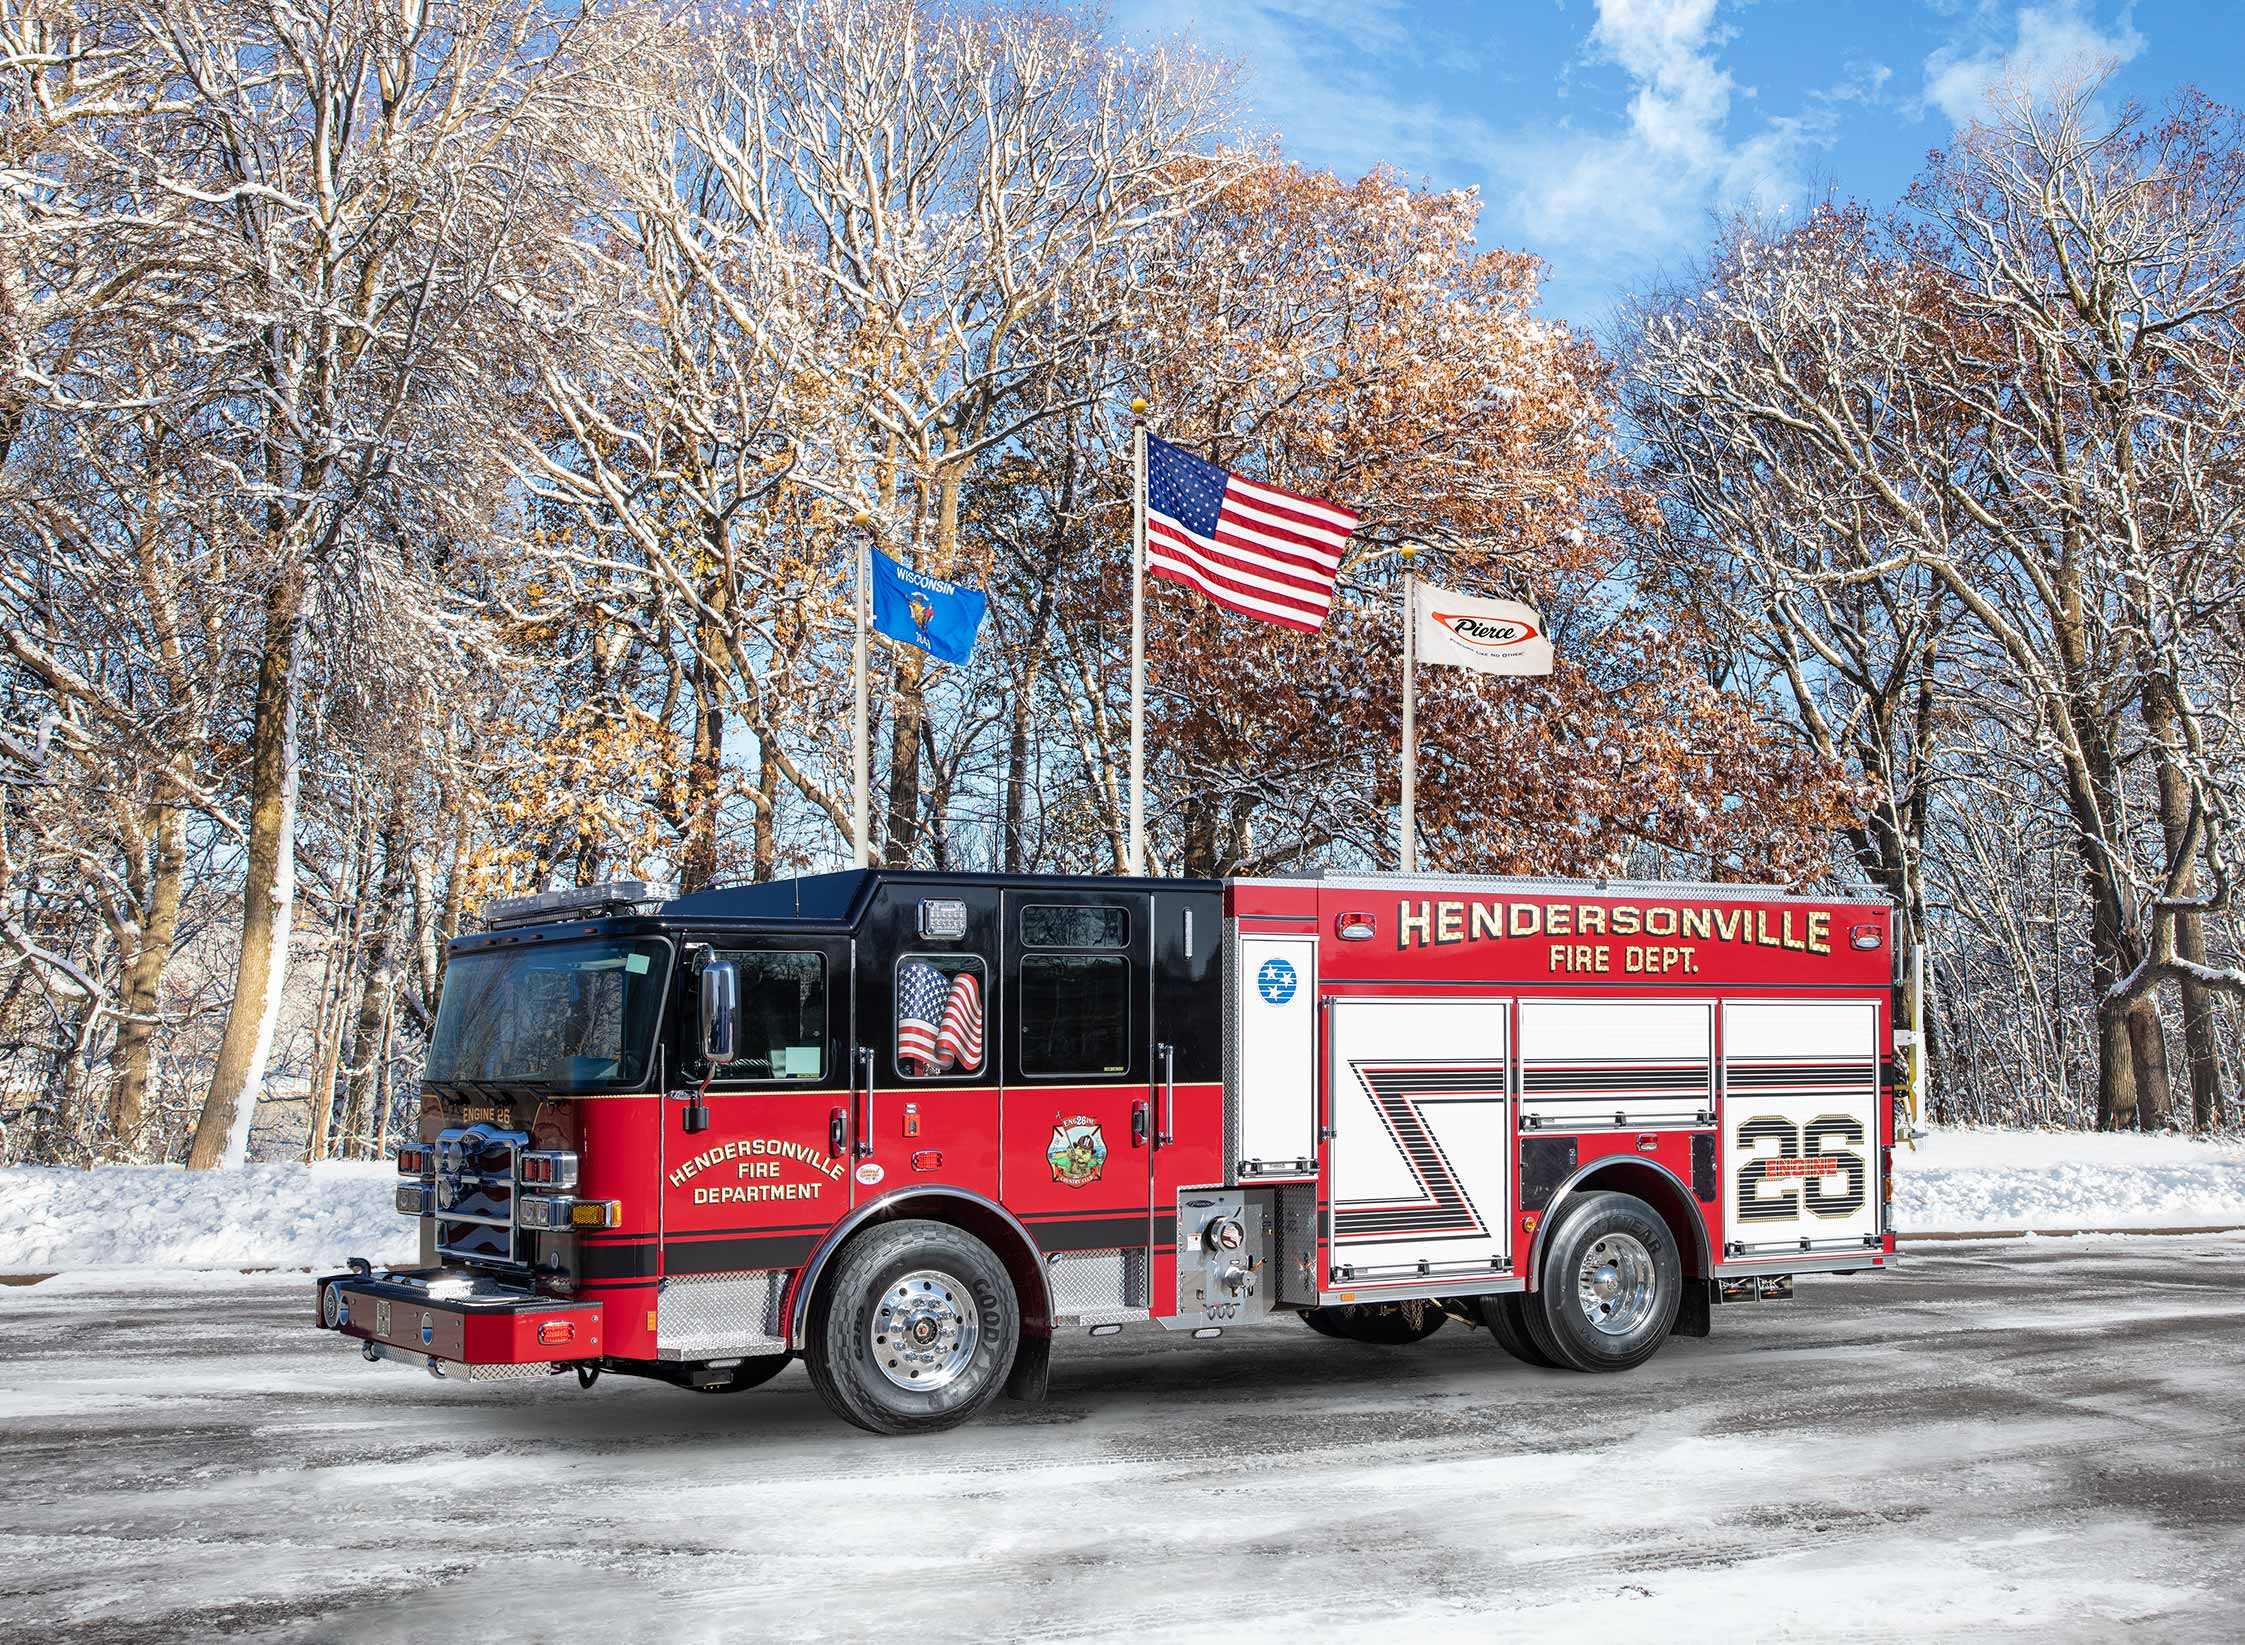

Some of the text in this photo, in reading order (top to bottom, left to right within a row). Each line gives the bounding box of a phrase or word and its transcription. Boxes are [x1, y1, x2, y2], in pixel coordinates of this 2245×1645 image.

[896, 567, 955, 595] WISCONSIN
[1454, 618, 1516, 639] Pierce
[1398, 900, 1831, 954] HENDERSONVILLE
[1549, 945, 1699, 974] FIRE DEPT.
[463, 1107, 511, 1125] ENGINE 26
[669, 1139, 845, 1188] HENDERSONVILLE
[738, 1162, 780, 1179] FIRE
[1737, 1113, 1865, 1224] 26
[1765, 1157, 1838, 1177] ENGINE
[694, 1182, 822, 1205] DEPARTMENT
[853, 1306, 864, 1361] G289
